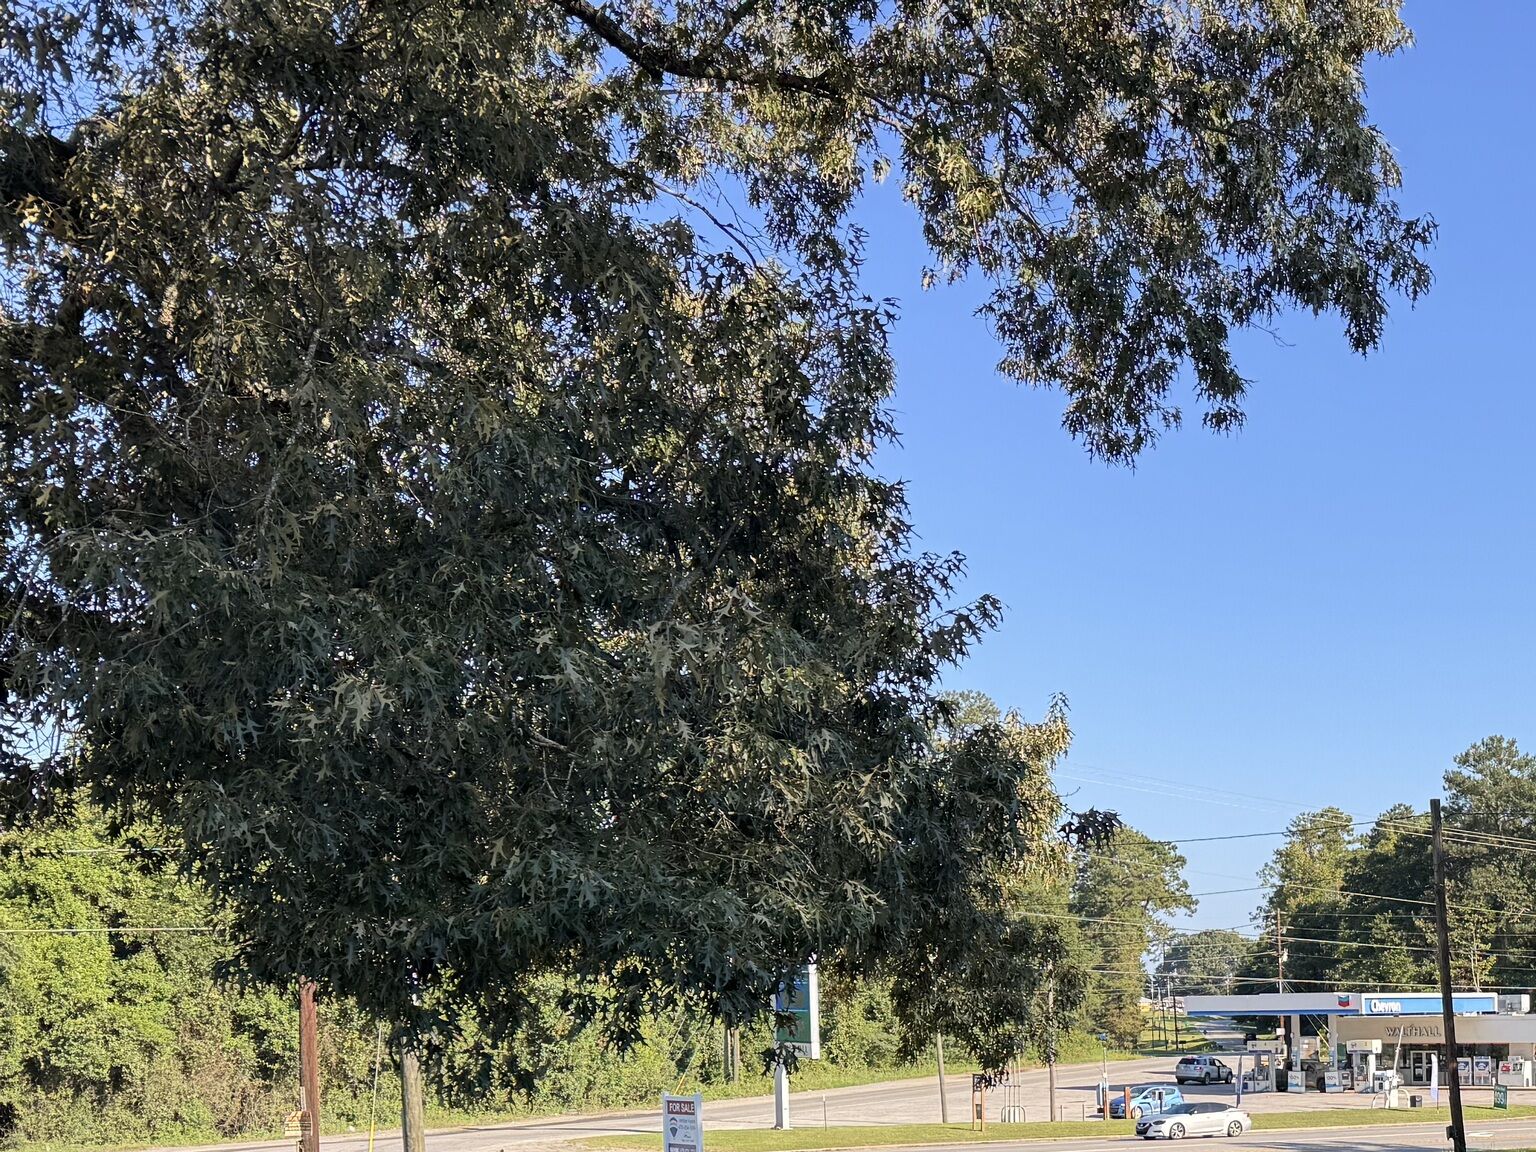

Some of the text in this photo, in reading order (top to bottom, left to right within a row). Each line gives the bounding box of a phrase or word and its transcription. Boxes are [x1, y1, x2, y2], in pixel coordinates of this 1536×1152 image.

[1370, 999, 1401, 1013] Chevron
[1385, 1025, 1441, 1037] WALTHALL
[669, 1102, 695, 1113] FOR SALE
